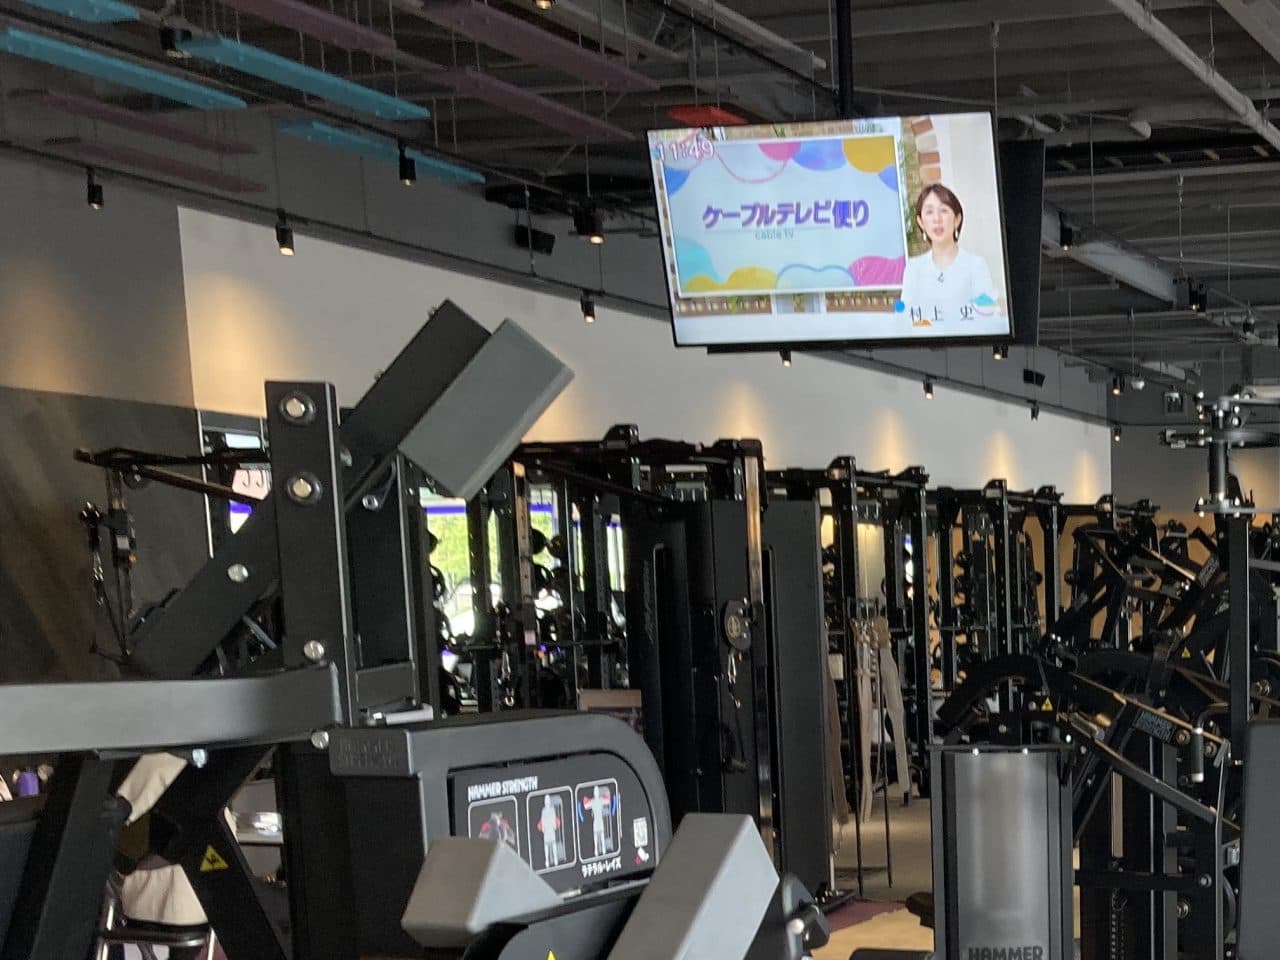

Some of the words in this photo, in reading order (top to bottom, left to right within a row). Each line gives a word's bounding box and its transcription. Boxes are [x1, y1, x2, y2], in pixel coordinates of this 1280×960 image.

[658, 137, 715, 161] 11:49
[467, 781, 502, 803] HAMMER
[502, 775, 539, 796] STRENGTH
